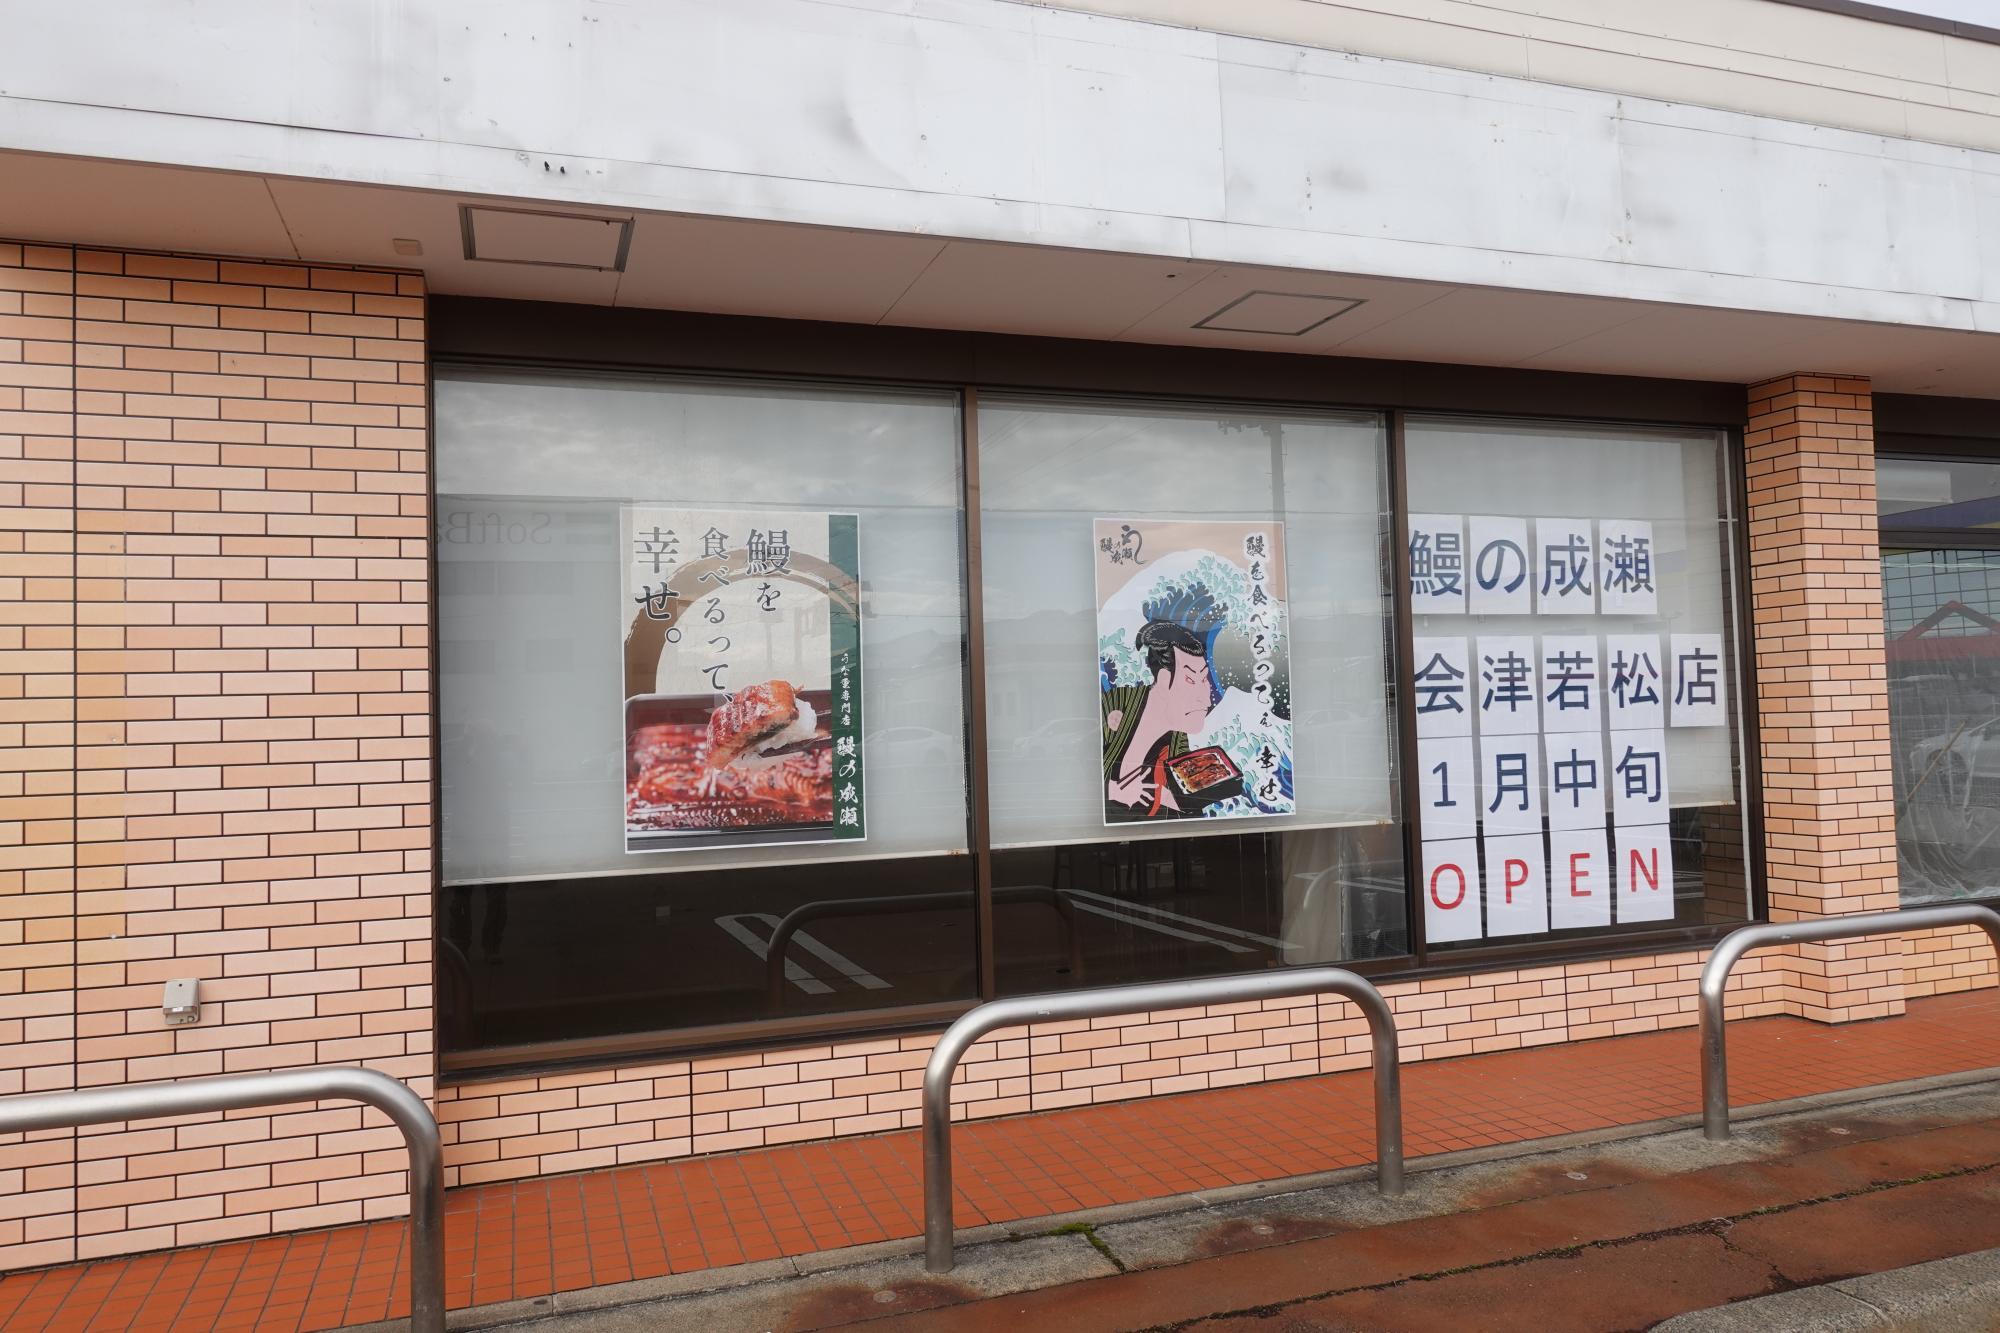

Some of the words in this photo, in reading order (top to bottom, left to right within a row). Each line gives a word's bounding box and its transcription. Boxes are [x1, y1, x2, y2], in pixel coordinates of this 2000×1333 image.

[633, 526, 682, 644] 幸せ。
[746, 528, 792, 612] 鰻を
[1408, 530, 1654, 597] 鰻の成瀬
[1414, 648, 1718, 715] 会津若松店
[837, 736, 859, 827] 鰻の成瀬
[1432, 746, 1662, 813] 1月中旬
[1430, 847, 1659, 910] OPEN
